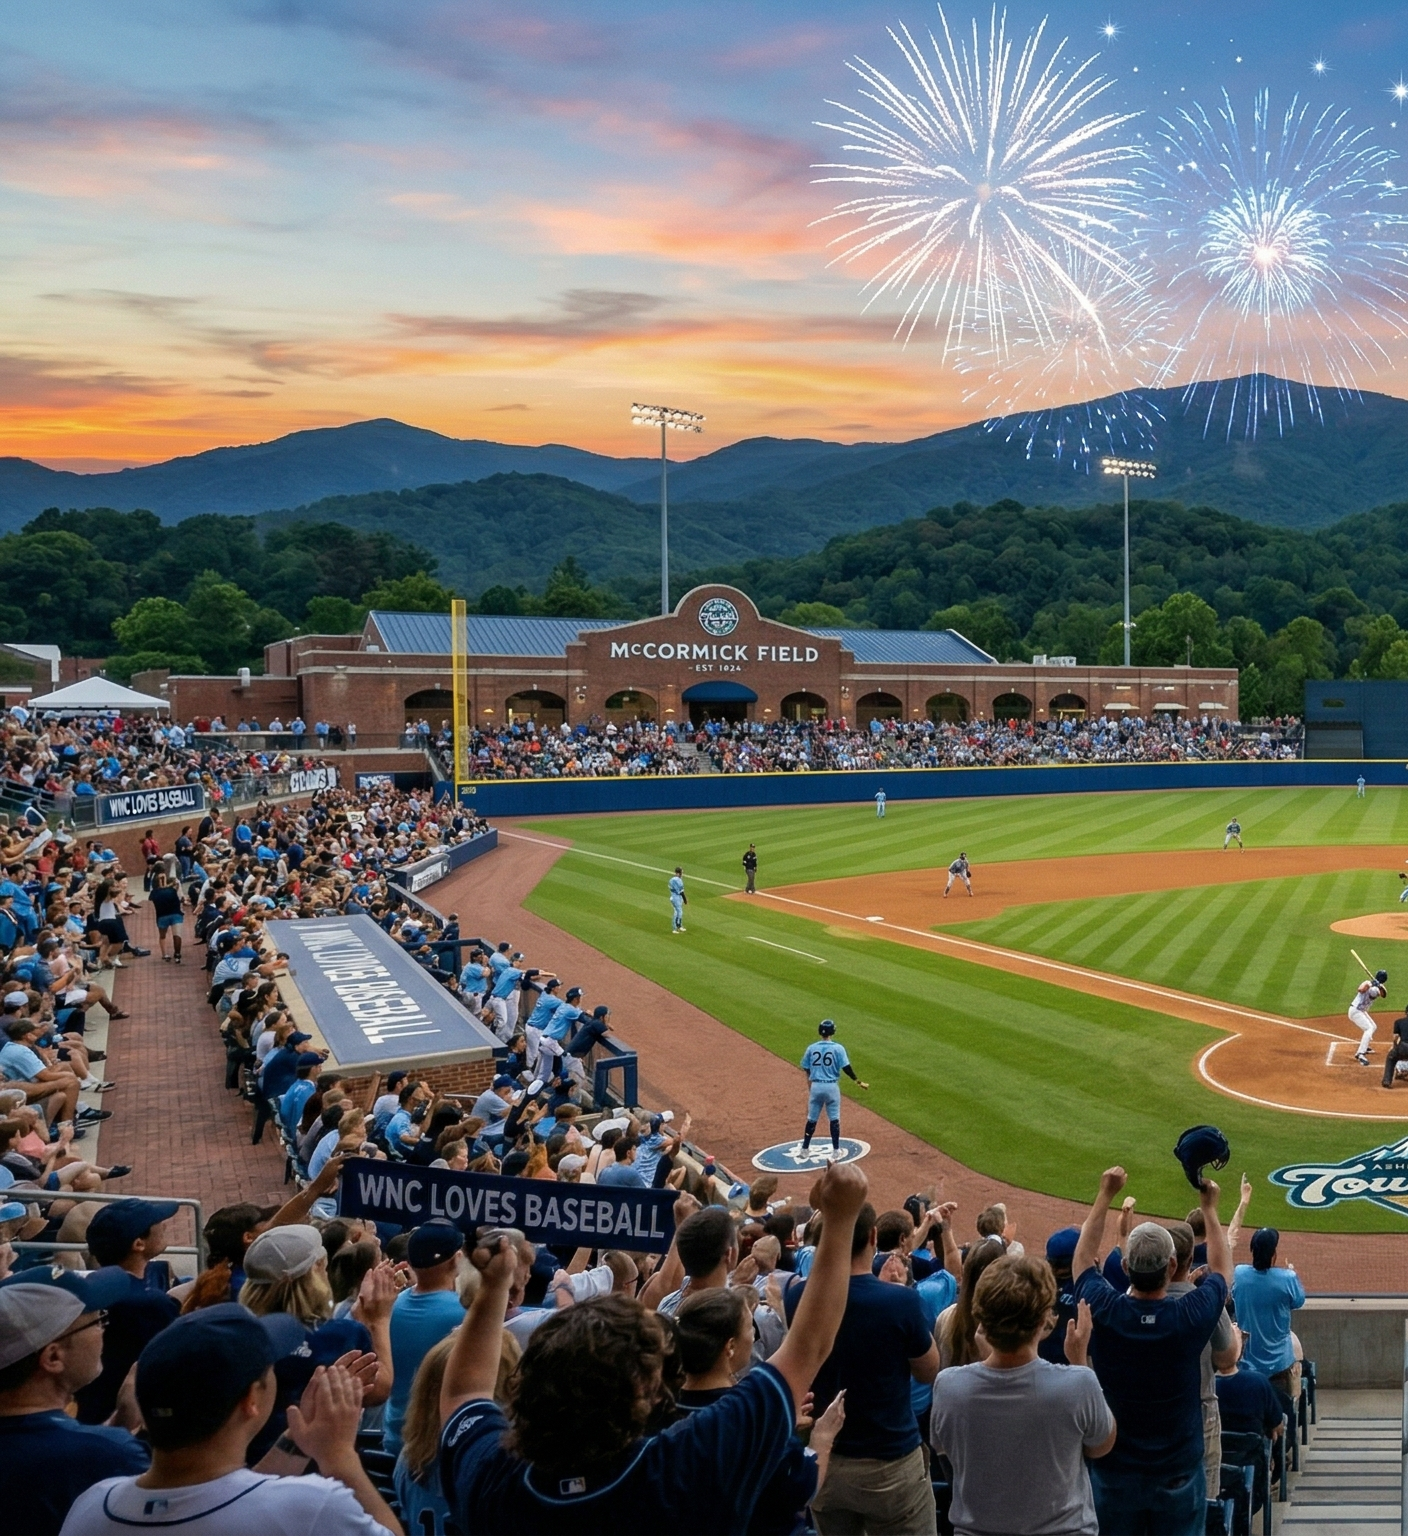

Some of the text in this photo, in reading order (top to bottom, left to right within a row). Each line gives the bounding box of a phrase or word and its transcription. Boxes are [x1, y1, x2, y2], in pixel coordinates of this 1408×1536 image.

[757, 646, 819, 662] FIELD
[695, 664, 713, 672] EST
[812, 1051, 832, 1066] 26
[358, 1172, 665, 1239] WNC LOVES BASEBALL
